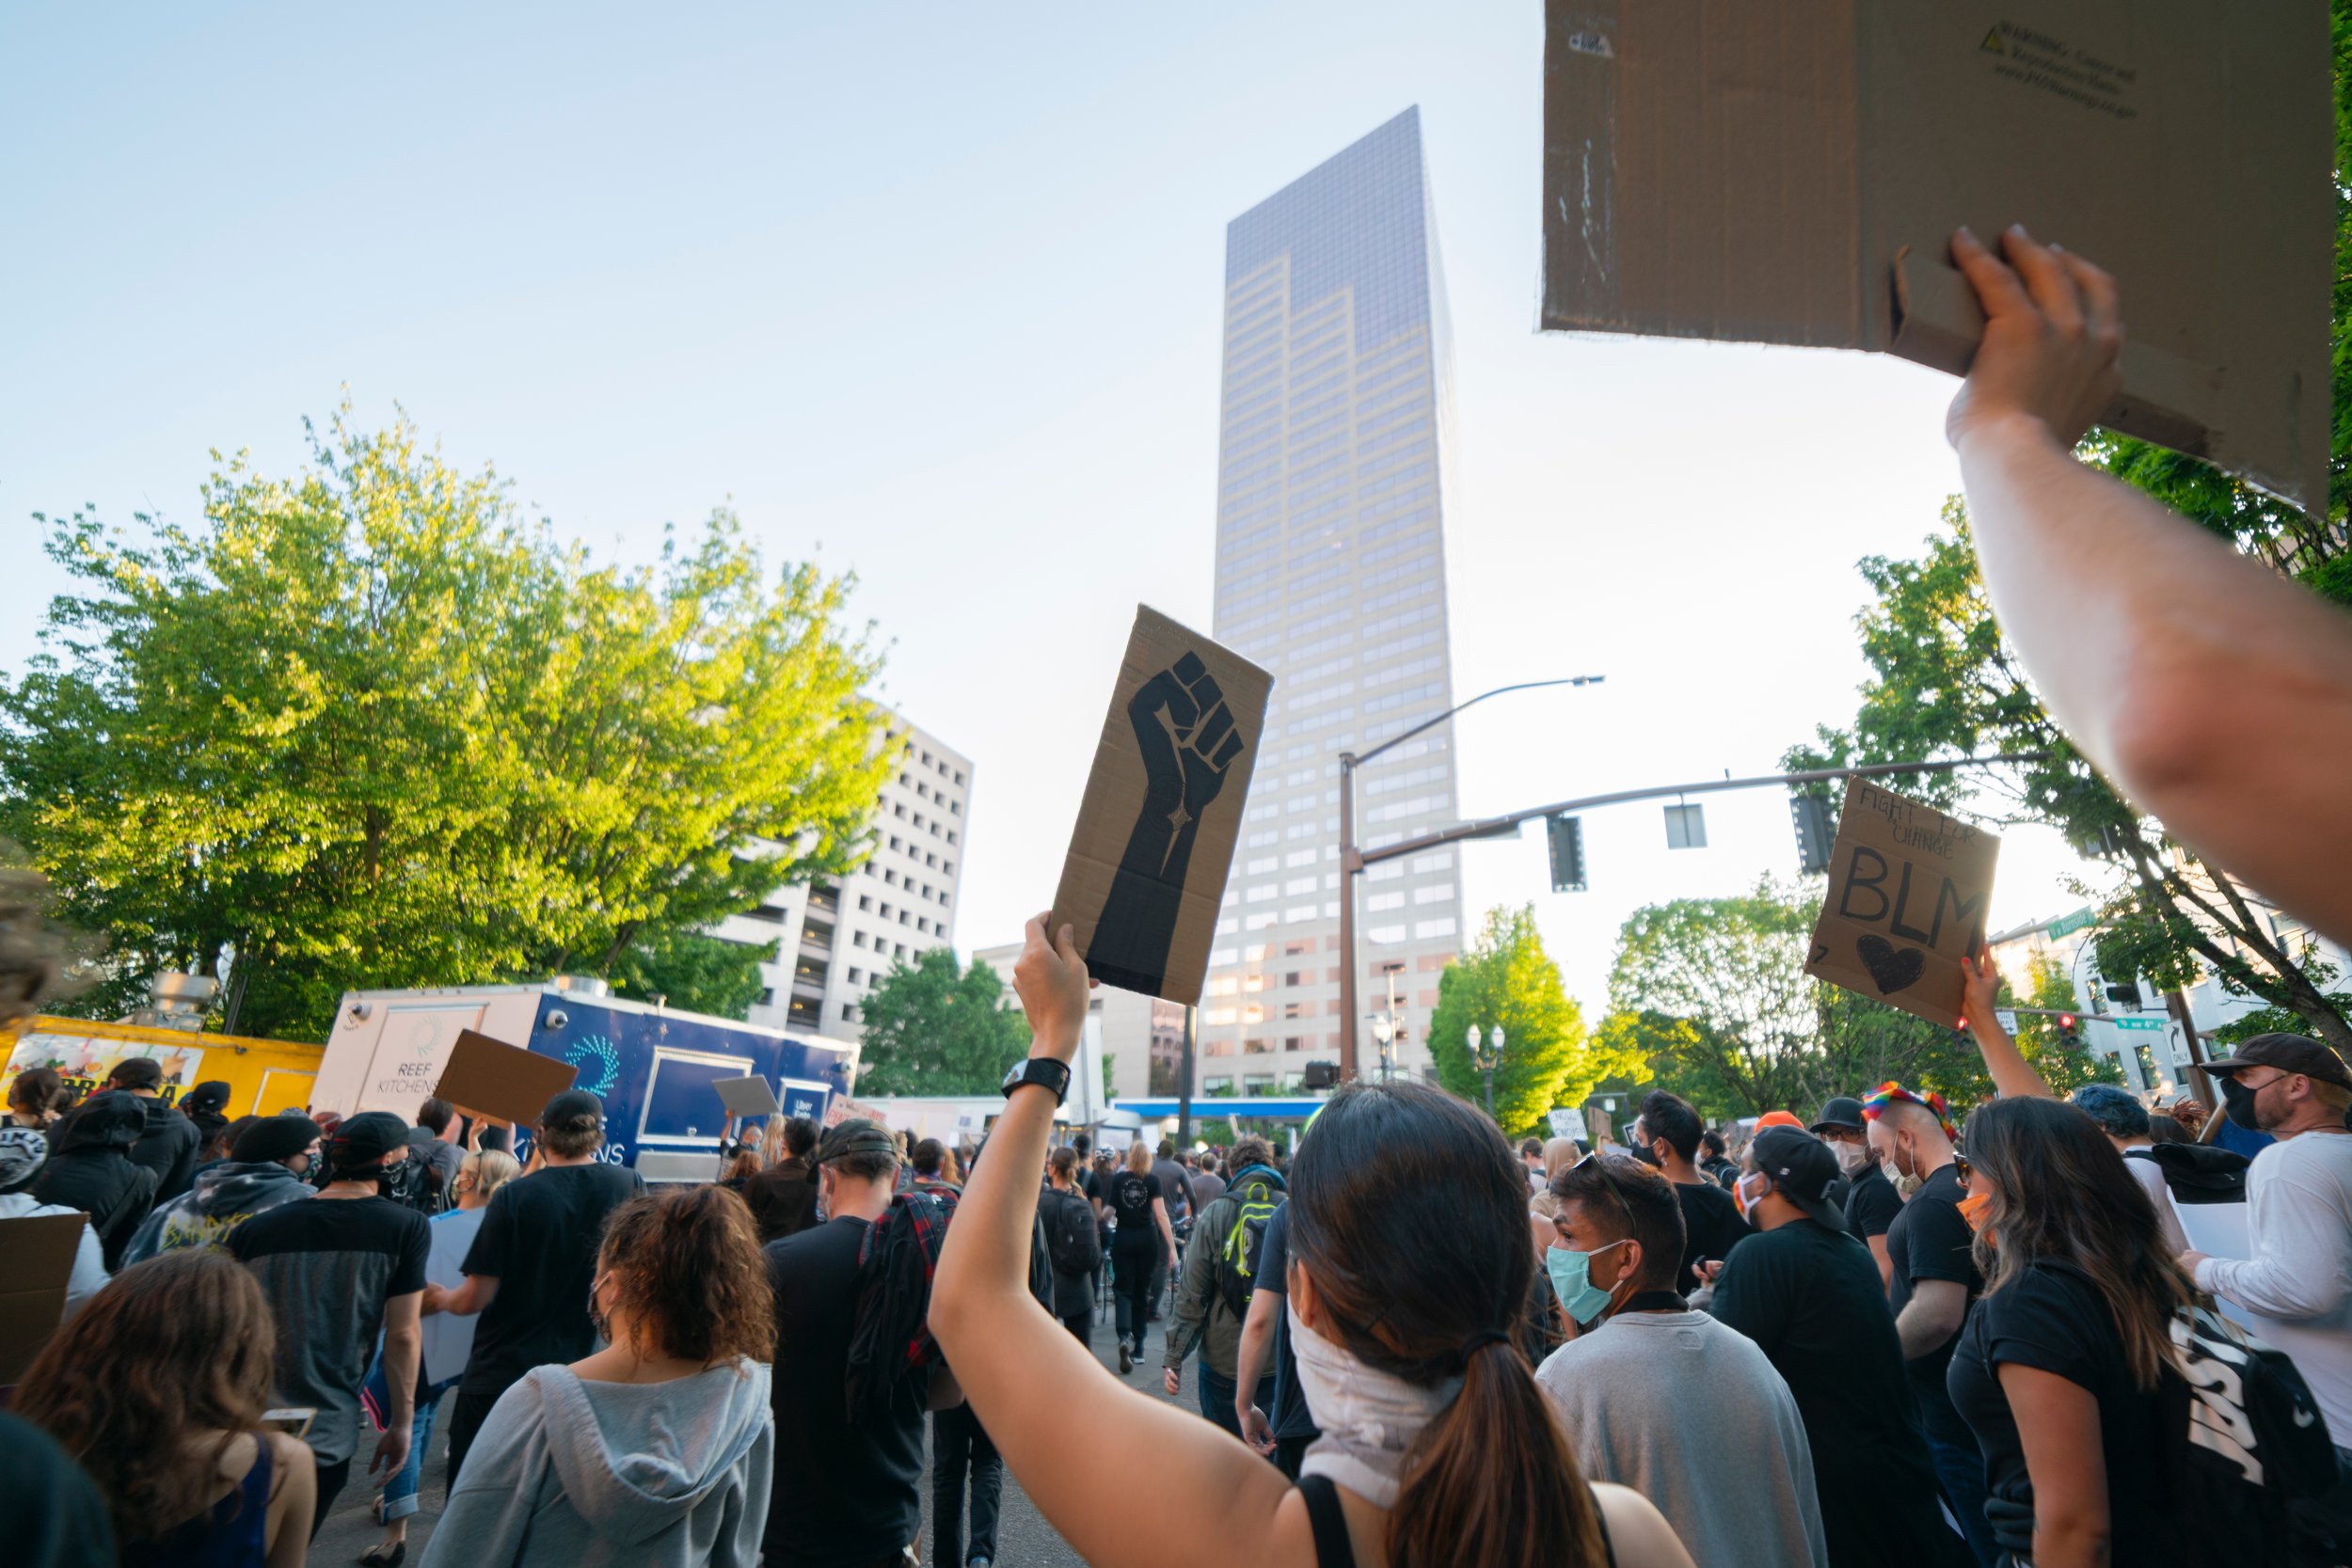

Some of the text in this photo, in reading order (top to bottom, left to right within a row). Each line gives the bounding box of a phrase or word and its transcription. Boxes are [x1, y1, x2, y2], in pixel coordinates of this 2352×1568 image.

[1860, 787, 1976, 844] FIGHT FOR
[1893, 825, 1953, 860] CHANGE
[1839, 846, 1987, 960] BLM
[398, 1063, 433, 1076] REEF
[2173, 1053, 2188, 1063] ONLY
[795, 1099, 813, 1111] Uber
